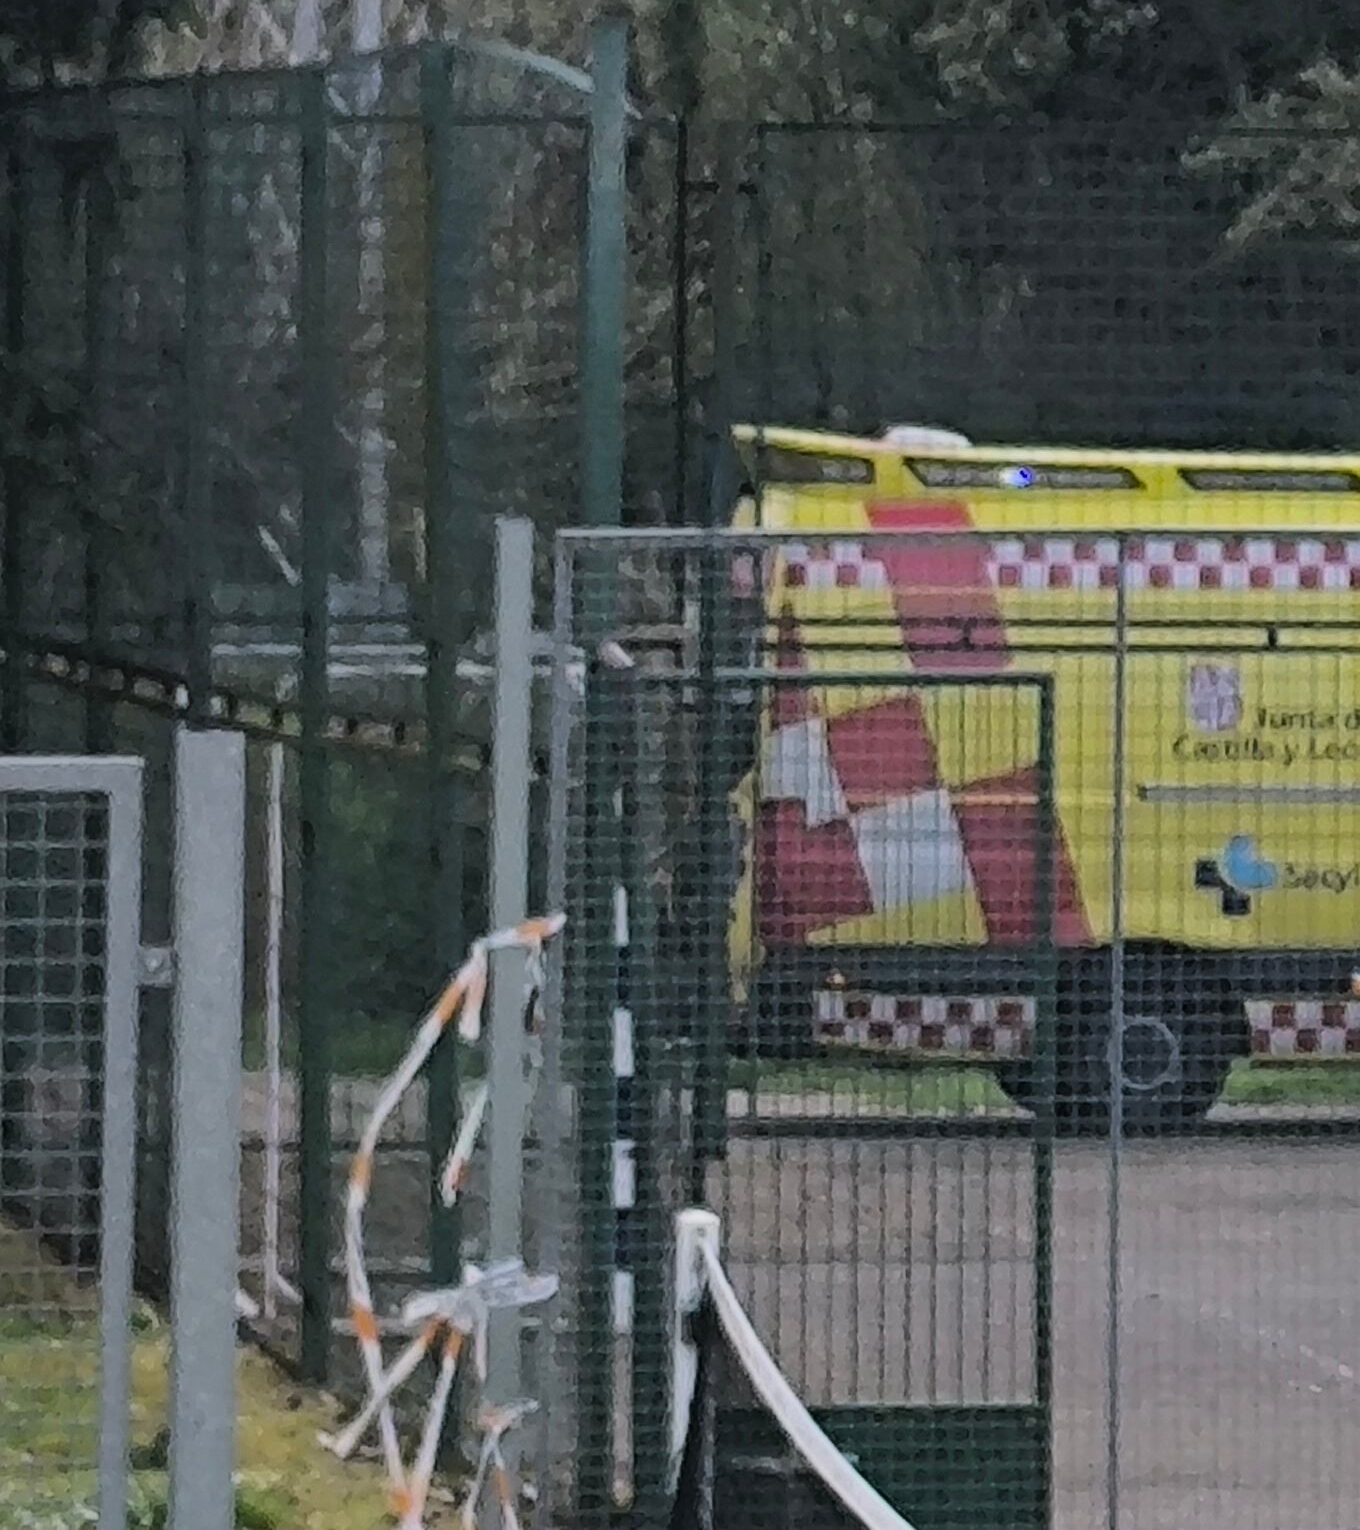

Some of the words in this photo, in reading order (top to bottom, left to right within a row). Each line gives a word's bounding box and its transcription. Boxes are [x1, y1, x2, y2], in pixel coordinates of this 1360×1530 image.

[1256, 707, 1337, 730] Junta
[1172, 734, 1275, 761] Castilla
[1282, 742, 1300, 767] y
